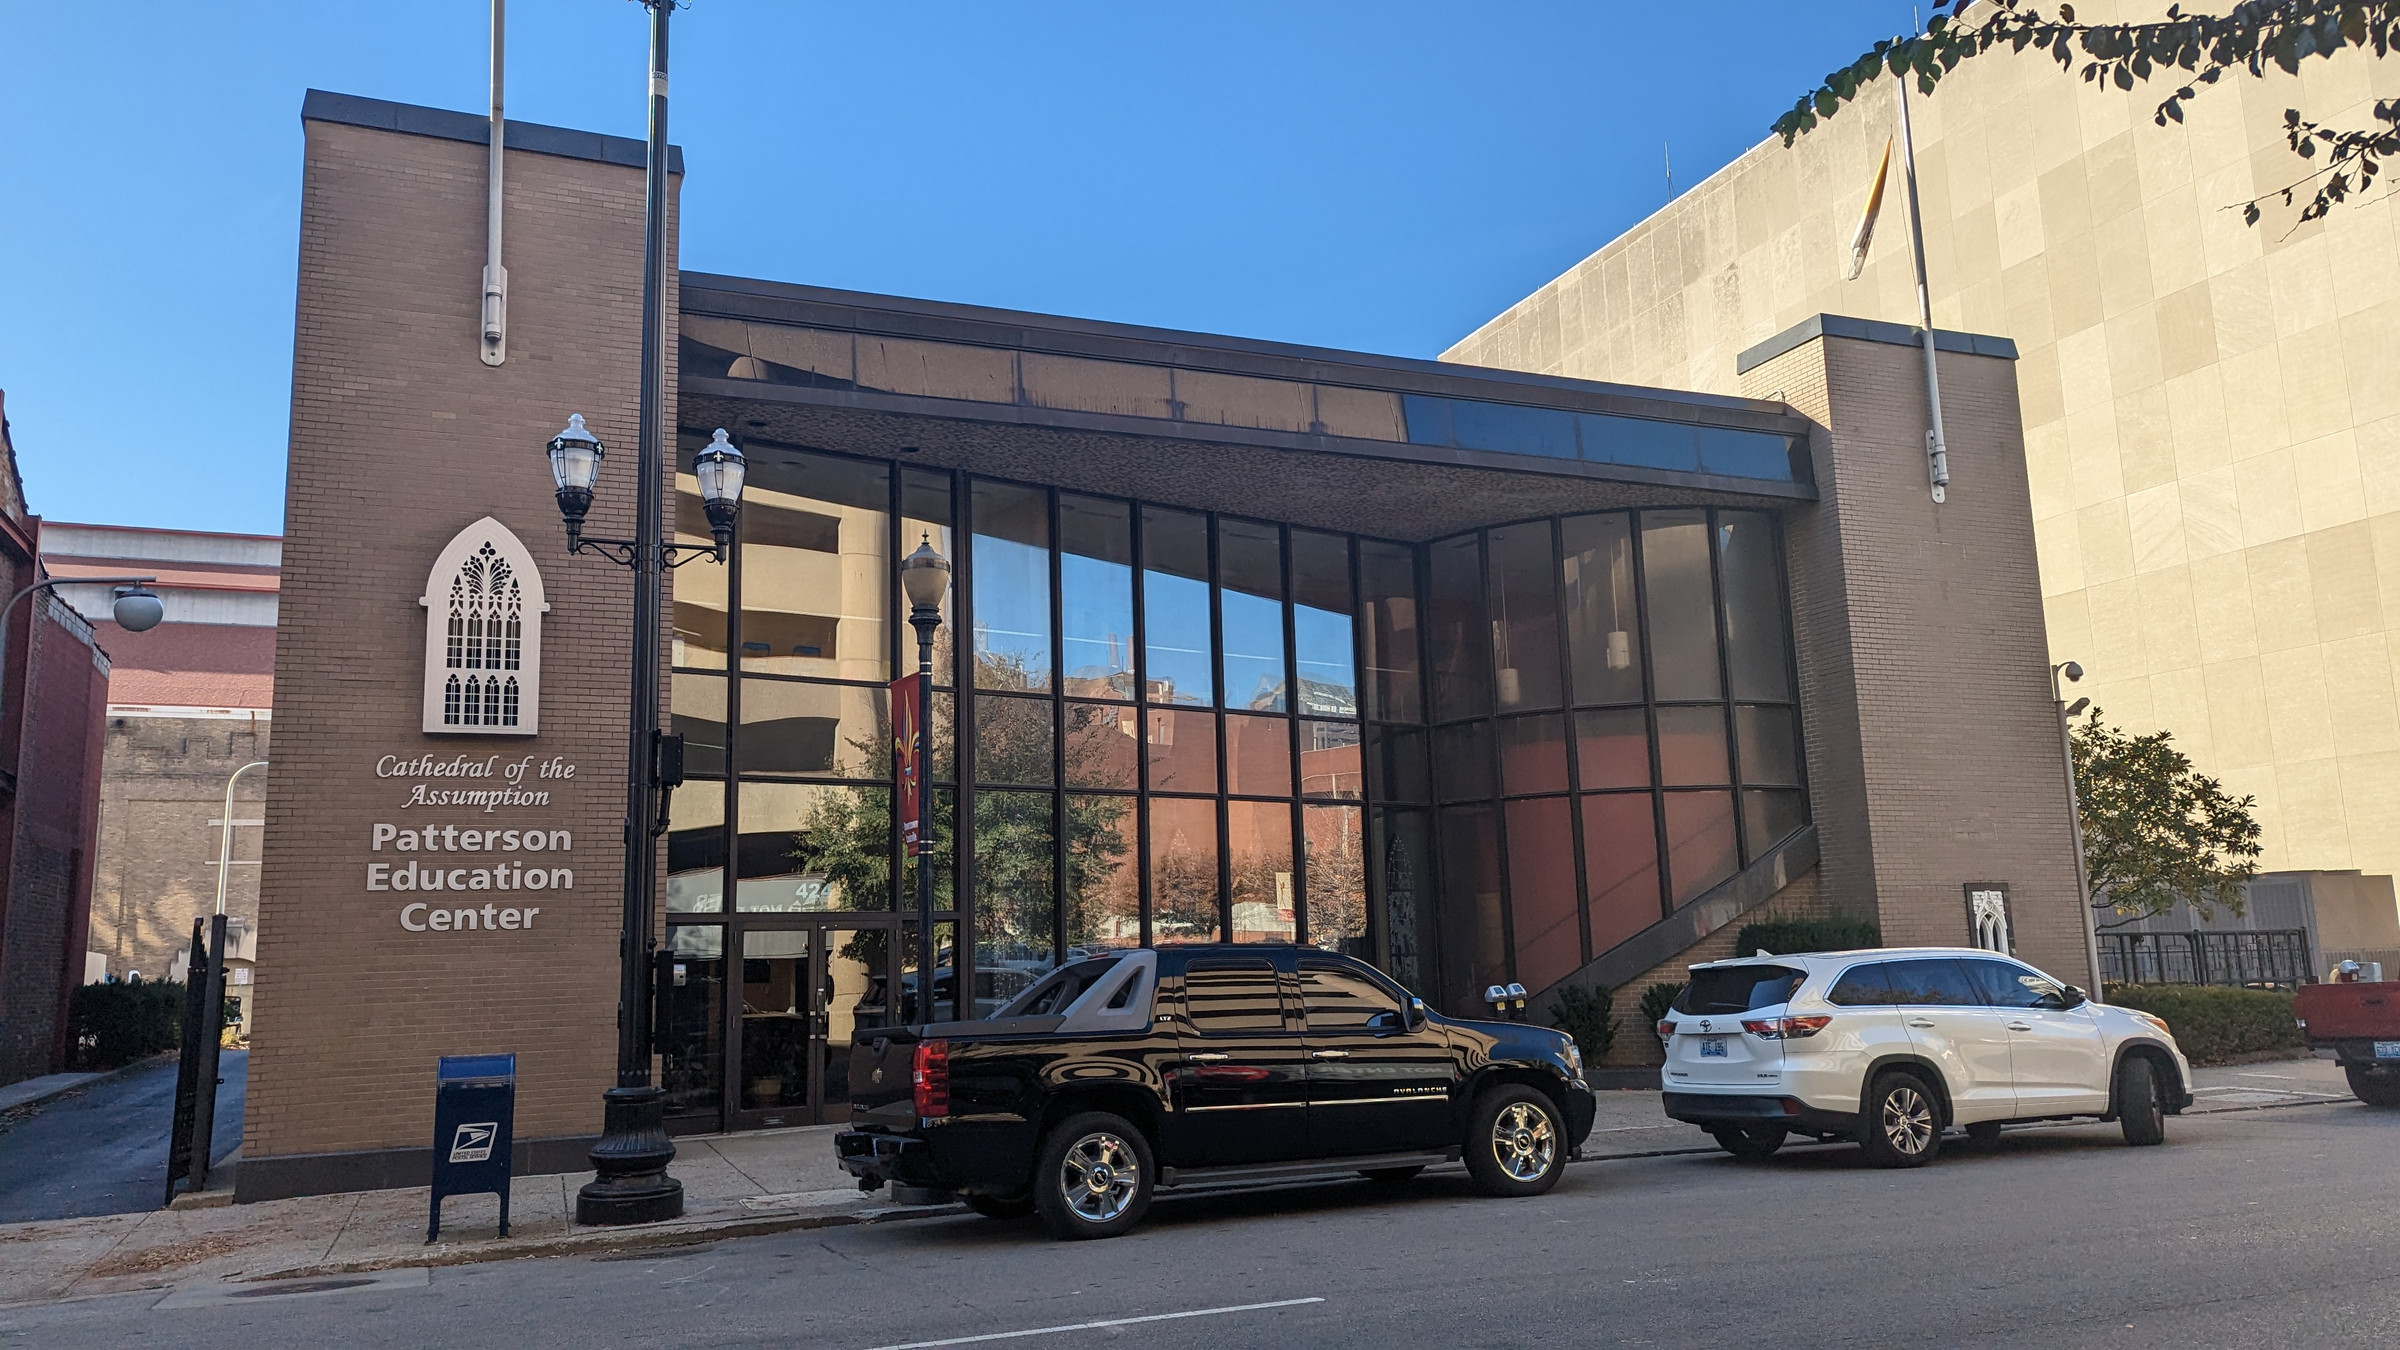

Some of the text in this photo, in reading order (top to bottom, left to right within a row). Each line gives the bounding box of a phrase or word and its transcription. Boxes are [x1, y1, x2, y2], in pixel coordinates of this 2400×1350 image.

[375, 753, 576, 785] Cathedral of the
[400, 783, 550, 813] Assumption
[371, 822, 572, 852] Patterson
[366, 860, 575, 892] Education
[795, 882, 832, 899] 424
[400, 902, 540, 932] Center
[1393, 1086, 1448, 1094] AVALANCHE
